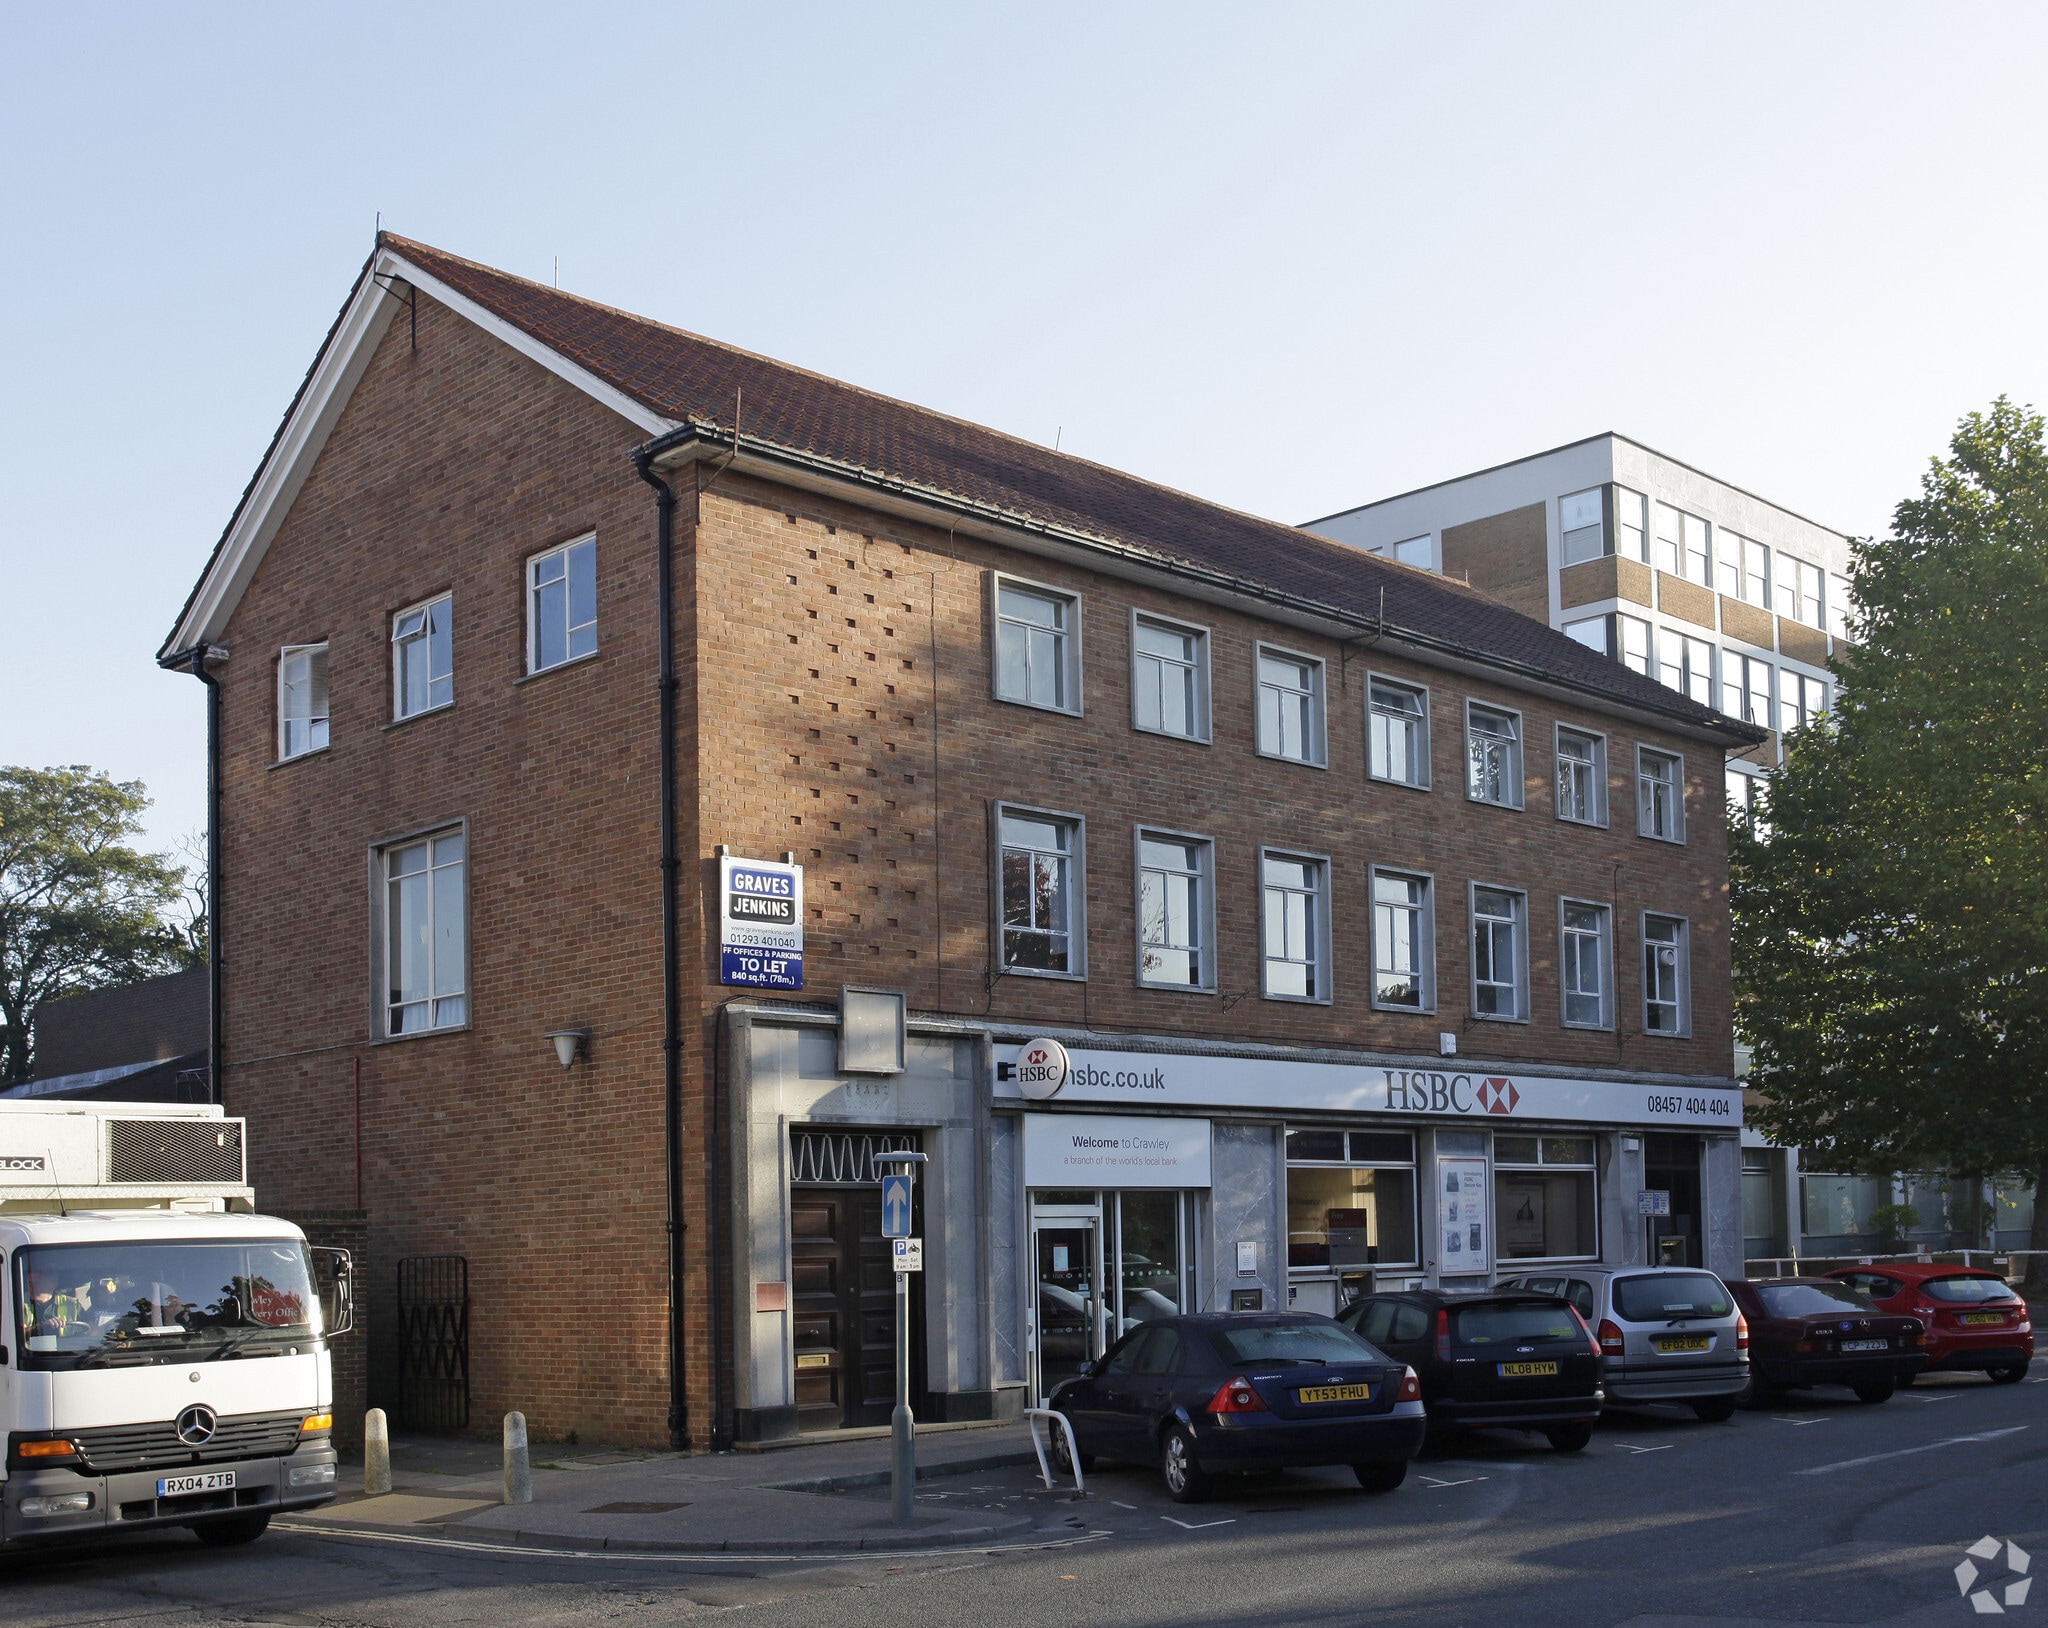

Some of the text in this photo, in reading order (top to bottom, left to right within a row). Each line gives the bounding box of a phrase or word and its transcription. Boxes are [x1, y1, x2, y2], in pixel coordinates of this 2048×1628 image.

[735, 873, 789, 895] GRAVES
[733, 898, 789, 917] JENKINS
[731, 925, 794, 936] www.gravesjenkins.com
[730, 933, 795, 948] 01293 401040
[723, 946, 732, 954] FF
[733, 948, 763, 957] OFFICES
[771, 951, 802, 960] PARKING
[739, 957, 788, 974] TO LET
[731, 971, 747, 980] 840
[1020, 1066, 1058, 1082] HSBC
[1383, 1070, 1473, 1113] HSBC
[1647, 1095, 1730, 1116] 08457 404 404
[1072, 1135, 1170, 1151] Welcome to Crawley
[1063, 1156, 1178, 1166] a branch of the world's local bank
[1662, 1340, 1686, 1350] EF02
[1504, 1362, 1555, 1375] NL08 HYM
[1305, 1386, 1364, 1401] YT53 FHU
[167, 1473, 233, 1493] RX04 ZTB
